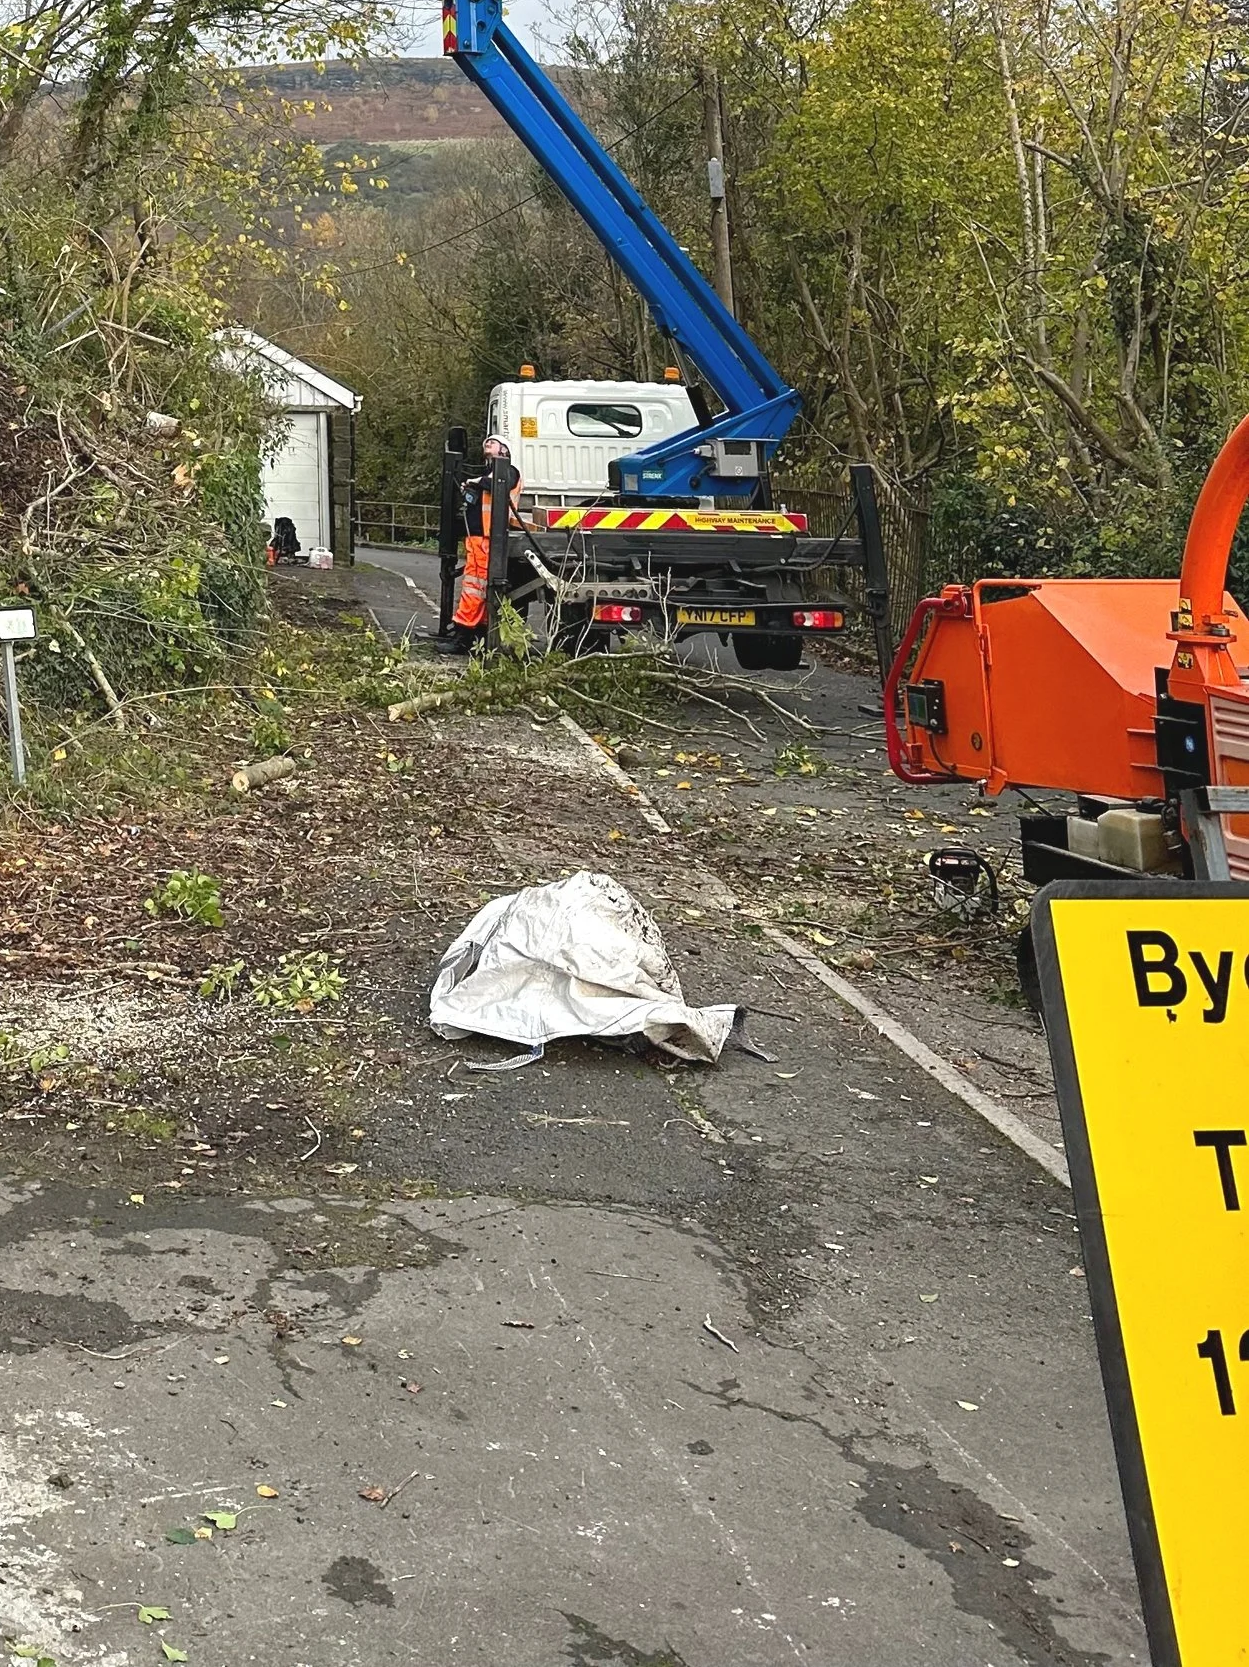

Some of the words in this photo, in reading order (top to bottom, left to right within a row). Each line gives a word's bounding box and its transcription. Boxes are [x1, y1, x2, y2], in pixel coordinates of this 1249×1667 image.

[685, 609, 716, 622] YN17
[719, 610, 747, 623] CFP
[1126, 930, 1249, 1024] By
